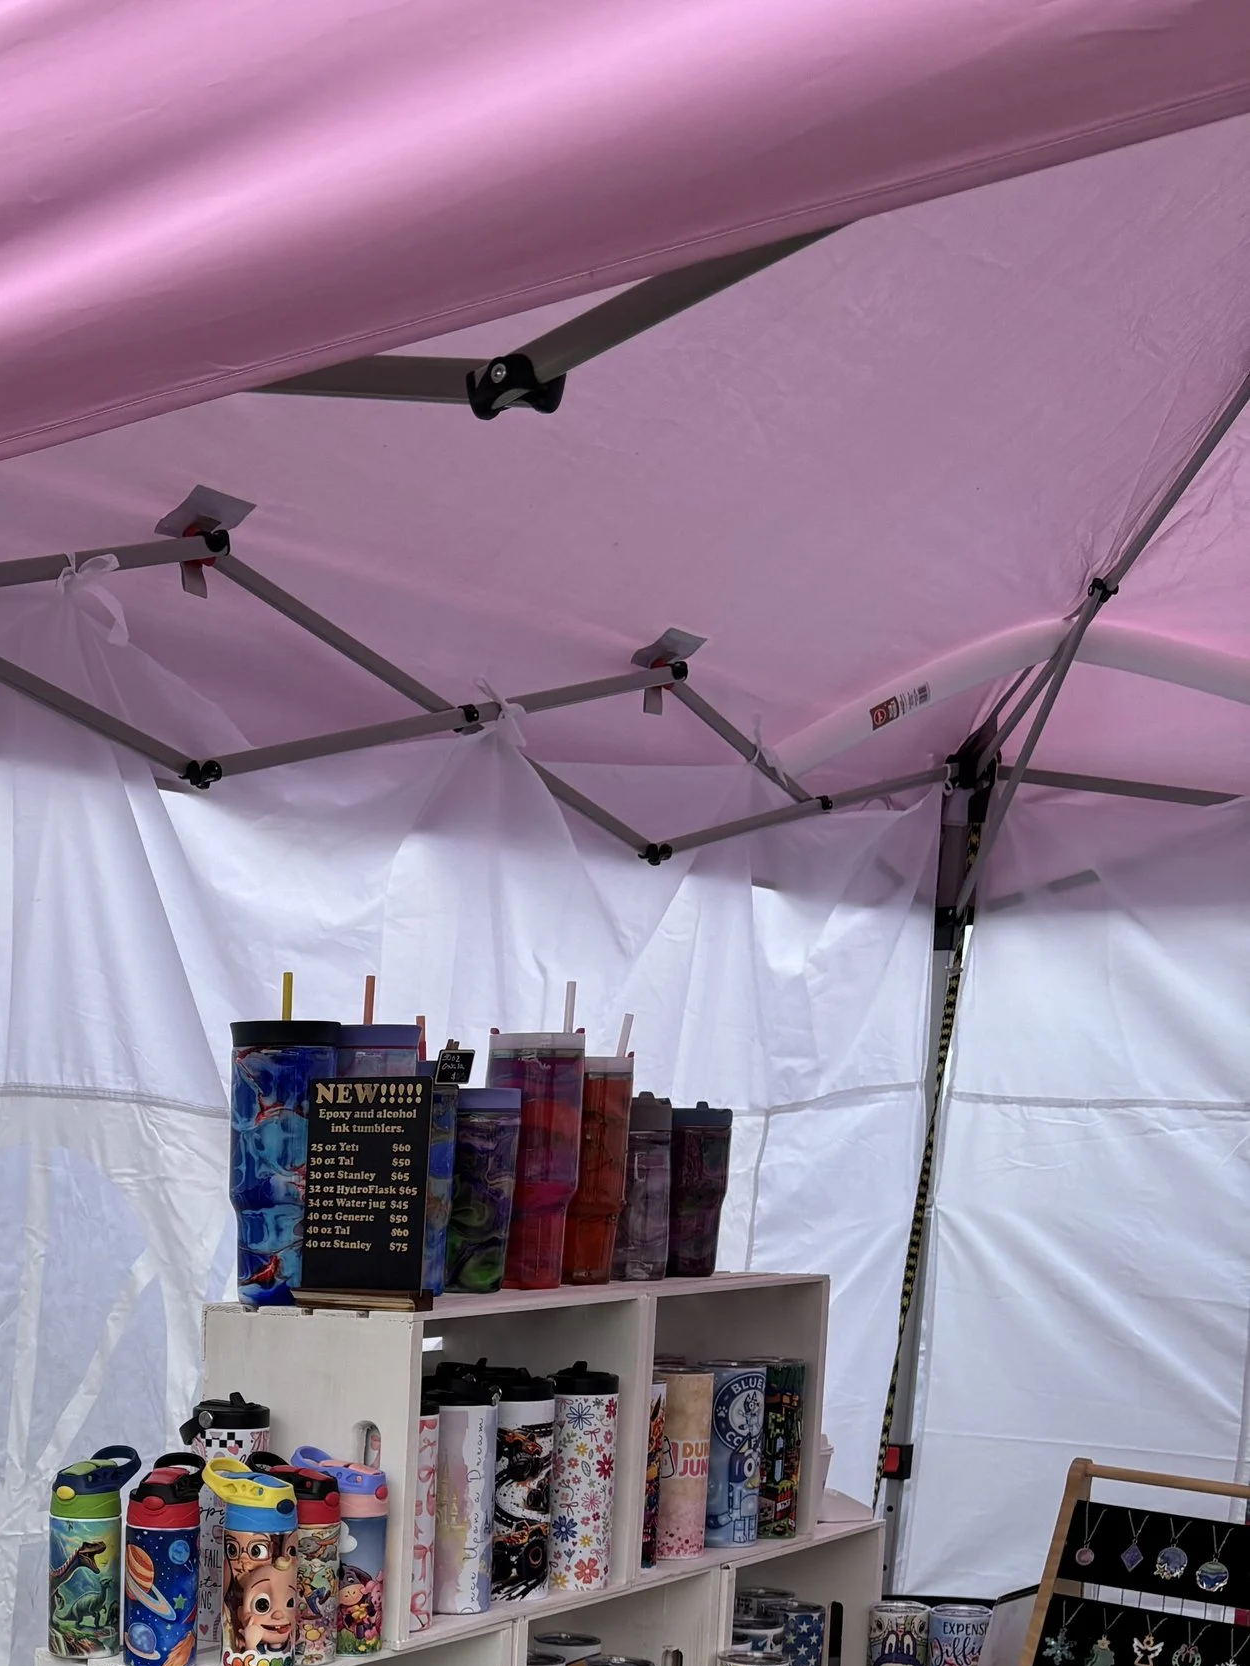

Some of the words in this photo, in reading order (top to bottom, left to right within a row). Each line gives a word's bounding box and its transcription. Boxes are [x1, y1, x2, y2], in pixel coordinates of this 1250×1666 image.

[315, 1083, 423, 1104] NEW!!!!!
[318, 1108, 352, 1120] Epoxy
[354, 1109, 375, 1119] and
[376, 1109, 417, 1119] alcohol
[331, 1123, 350, 1133] ink
[352, 1123, 405, 1133] tumblers.
[310, 1143, 323, 1152] 25
[325, 1144, 337, 1152] oz
[339, 1142, 359, 1152] Yeti
[392, 1143, 411, 1152] $60
[310, 1157, 322, 1166] 30
[324, 1158, 335, 1166] oz
[392, 1158, 411, 1167] $50
[309, 1171, 322, 1180] 30
[337, 1170, 376, 1182] Stanley
[391, 1171, 410, 1181] $65
[308, 1185, 321, 1194] 32
[336, 1185, 396, 1195] HydroFlask
[398, 1186, 418, 1196] $65
[308, 1199, 320, 1207] 34
[322, 1199, 334, 1207] oz
[336, 1198, 367, 1208] Water
[368, 1199, 386, 1210] jug
[390, 1200, 409, 1210] $45
[307, 1212, 319, 1221] 40
[321, 1213, 333, 1221] oz
[335, 1211, 375, 1222] Generic
[389, 1214, 408, 1224] $50
[306, 1226, 319, 1234] 40
[390, 1228, 409, 1237] $60
[305, 1239, 319, 1248] 40
[333, 1239, 372, 1251] Stanley
[389, 1242, 408, 1252] $75
[730, 1378, 766, 1395] BLUE
[466, 1418, 485, 1483] Dream
[473, 1492, 481, 1504] a
[462, 1512, 485, 1560] Upon
[943, 1621, 989, 1636] EXPENSI
